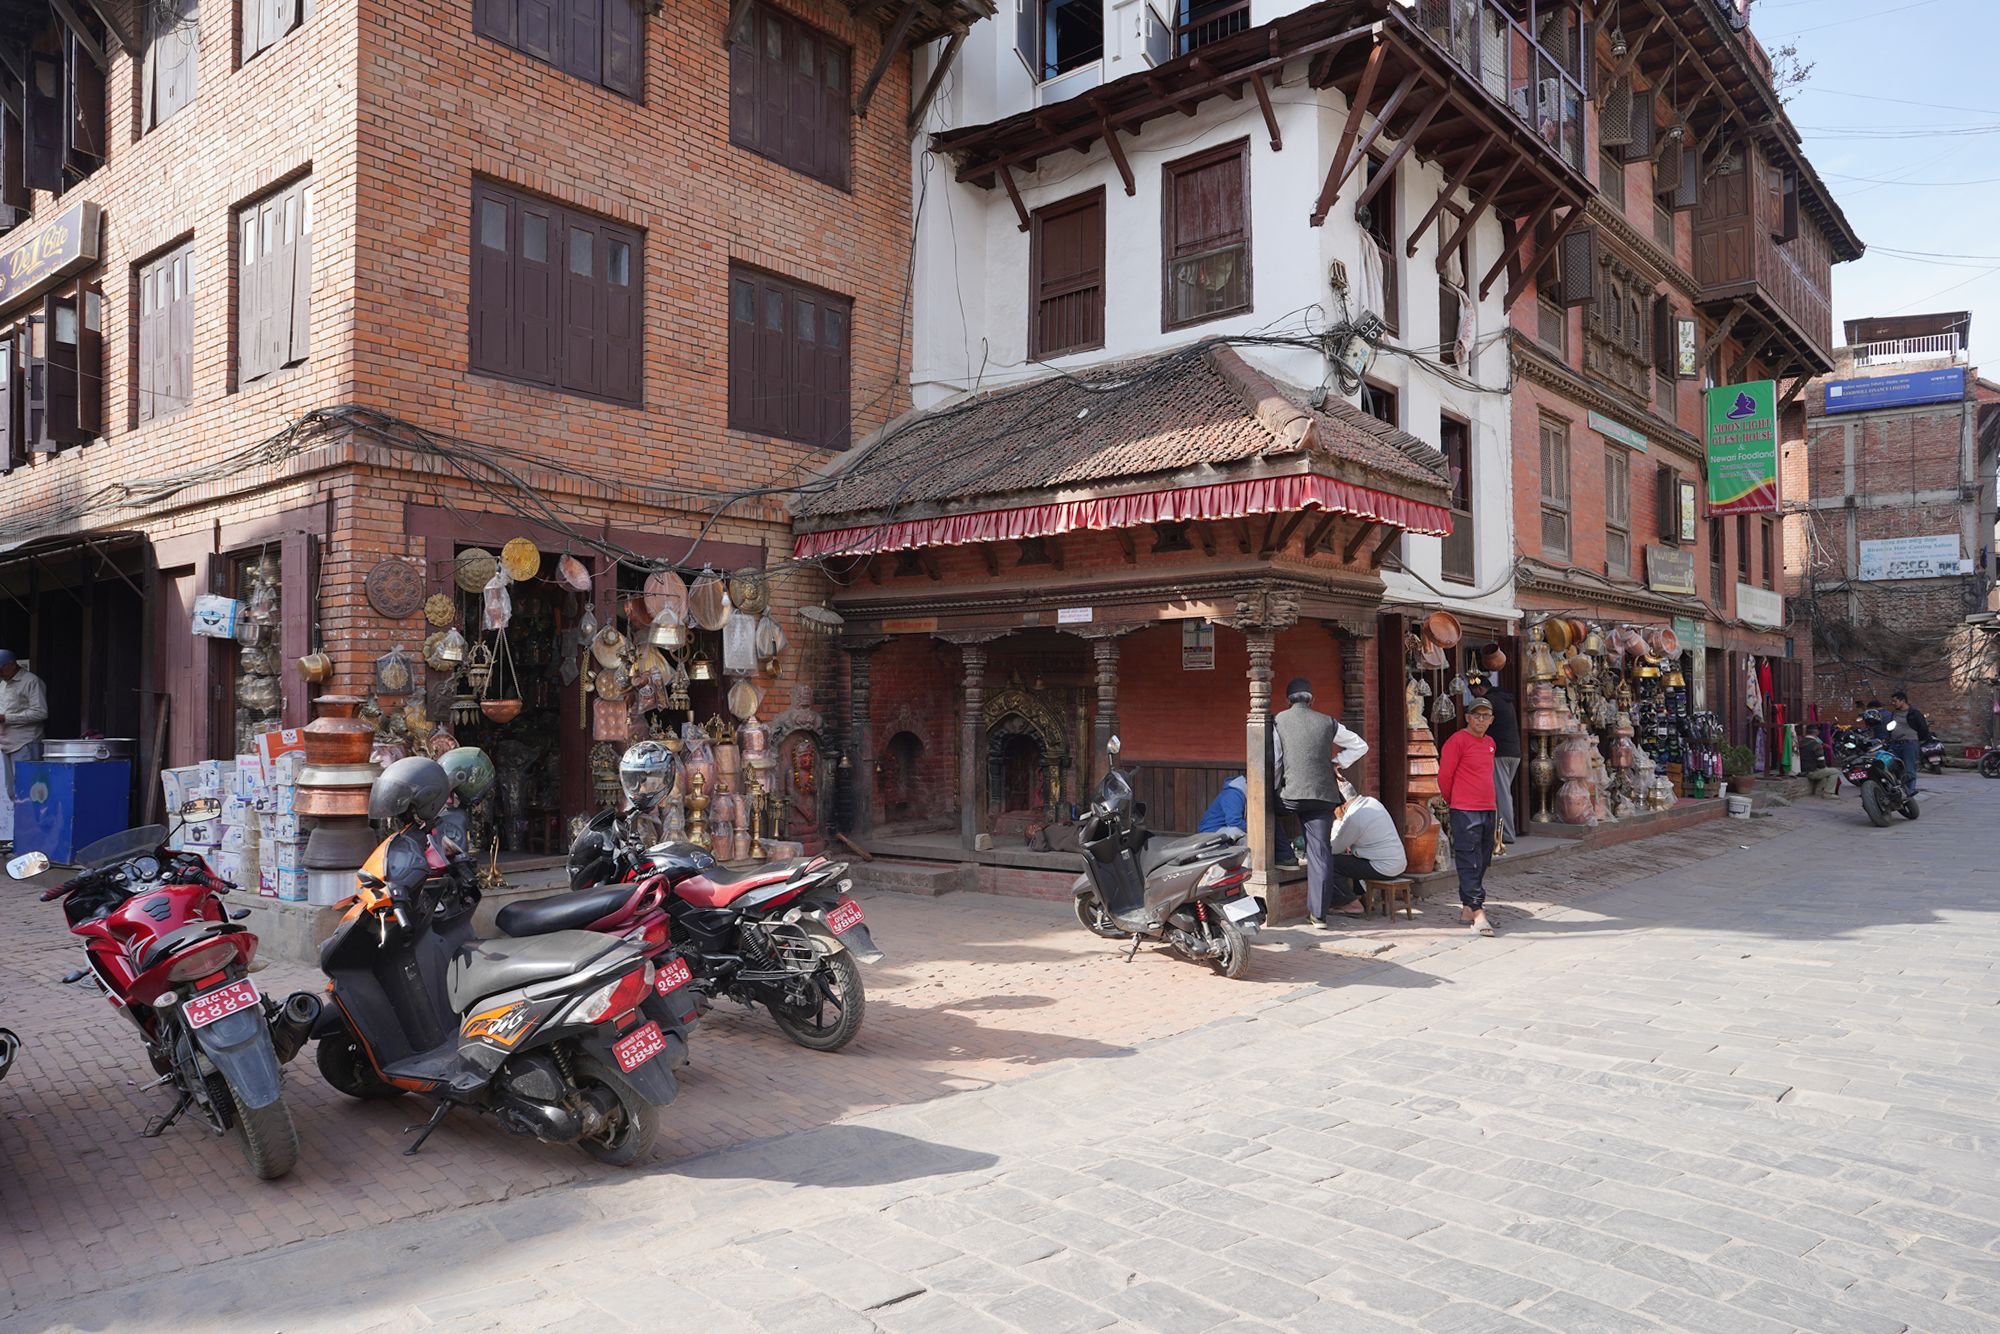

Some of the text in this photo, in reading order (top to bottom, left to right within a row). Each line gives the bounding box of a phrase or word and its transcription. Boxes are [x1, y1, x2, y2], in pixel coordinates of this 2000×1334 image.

[1713, 418, 1772, 434] MOON LIGHT
[1712, 430, 1772, 446] GUEST HOUSE
[1710, 449, 1775, 464] Newari Foodland
